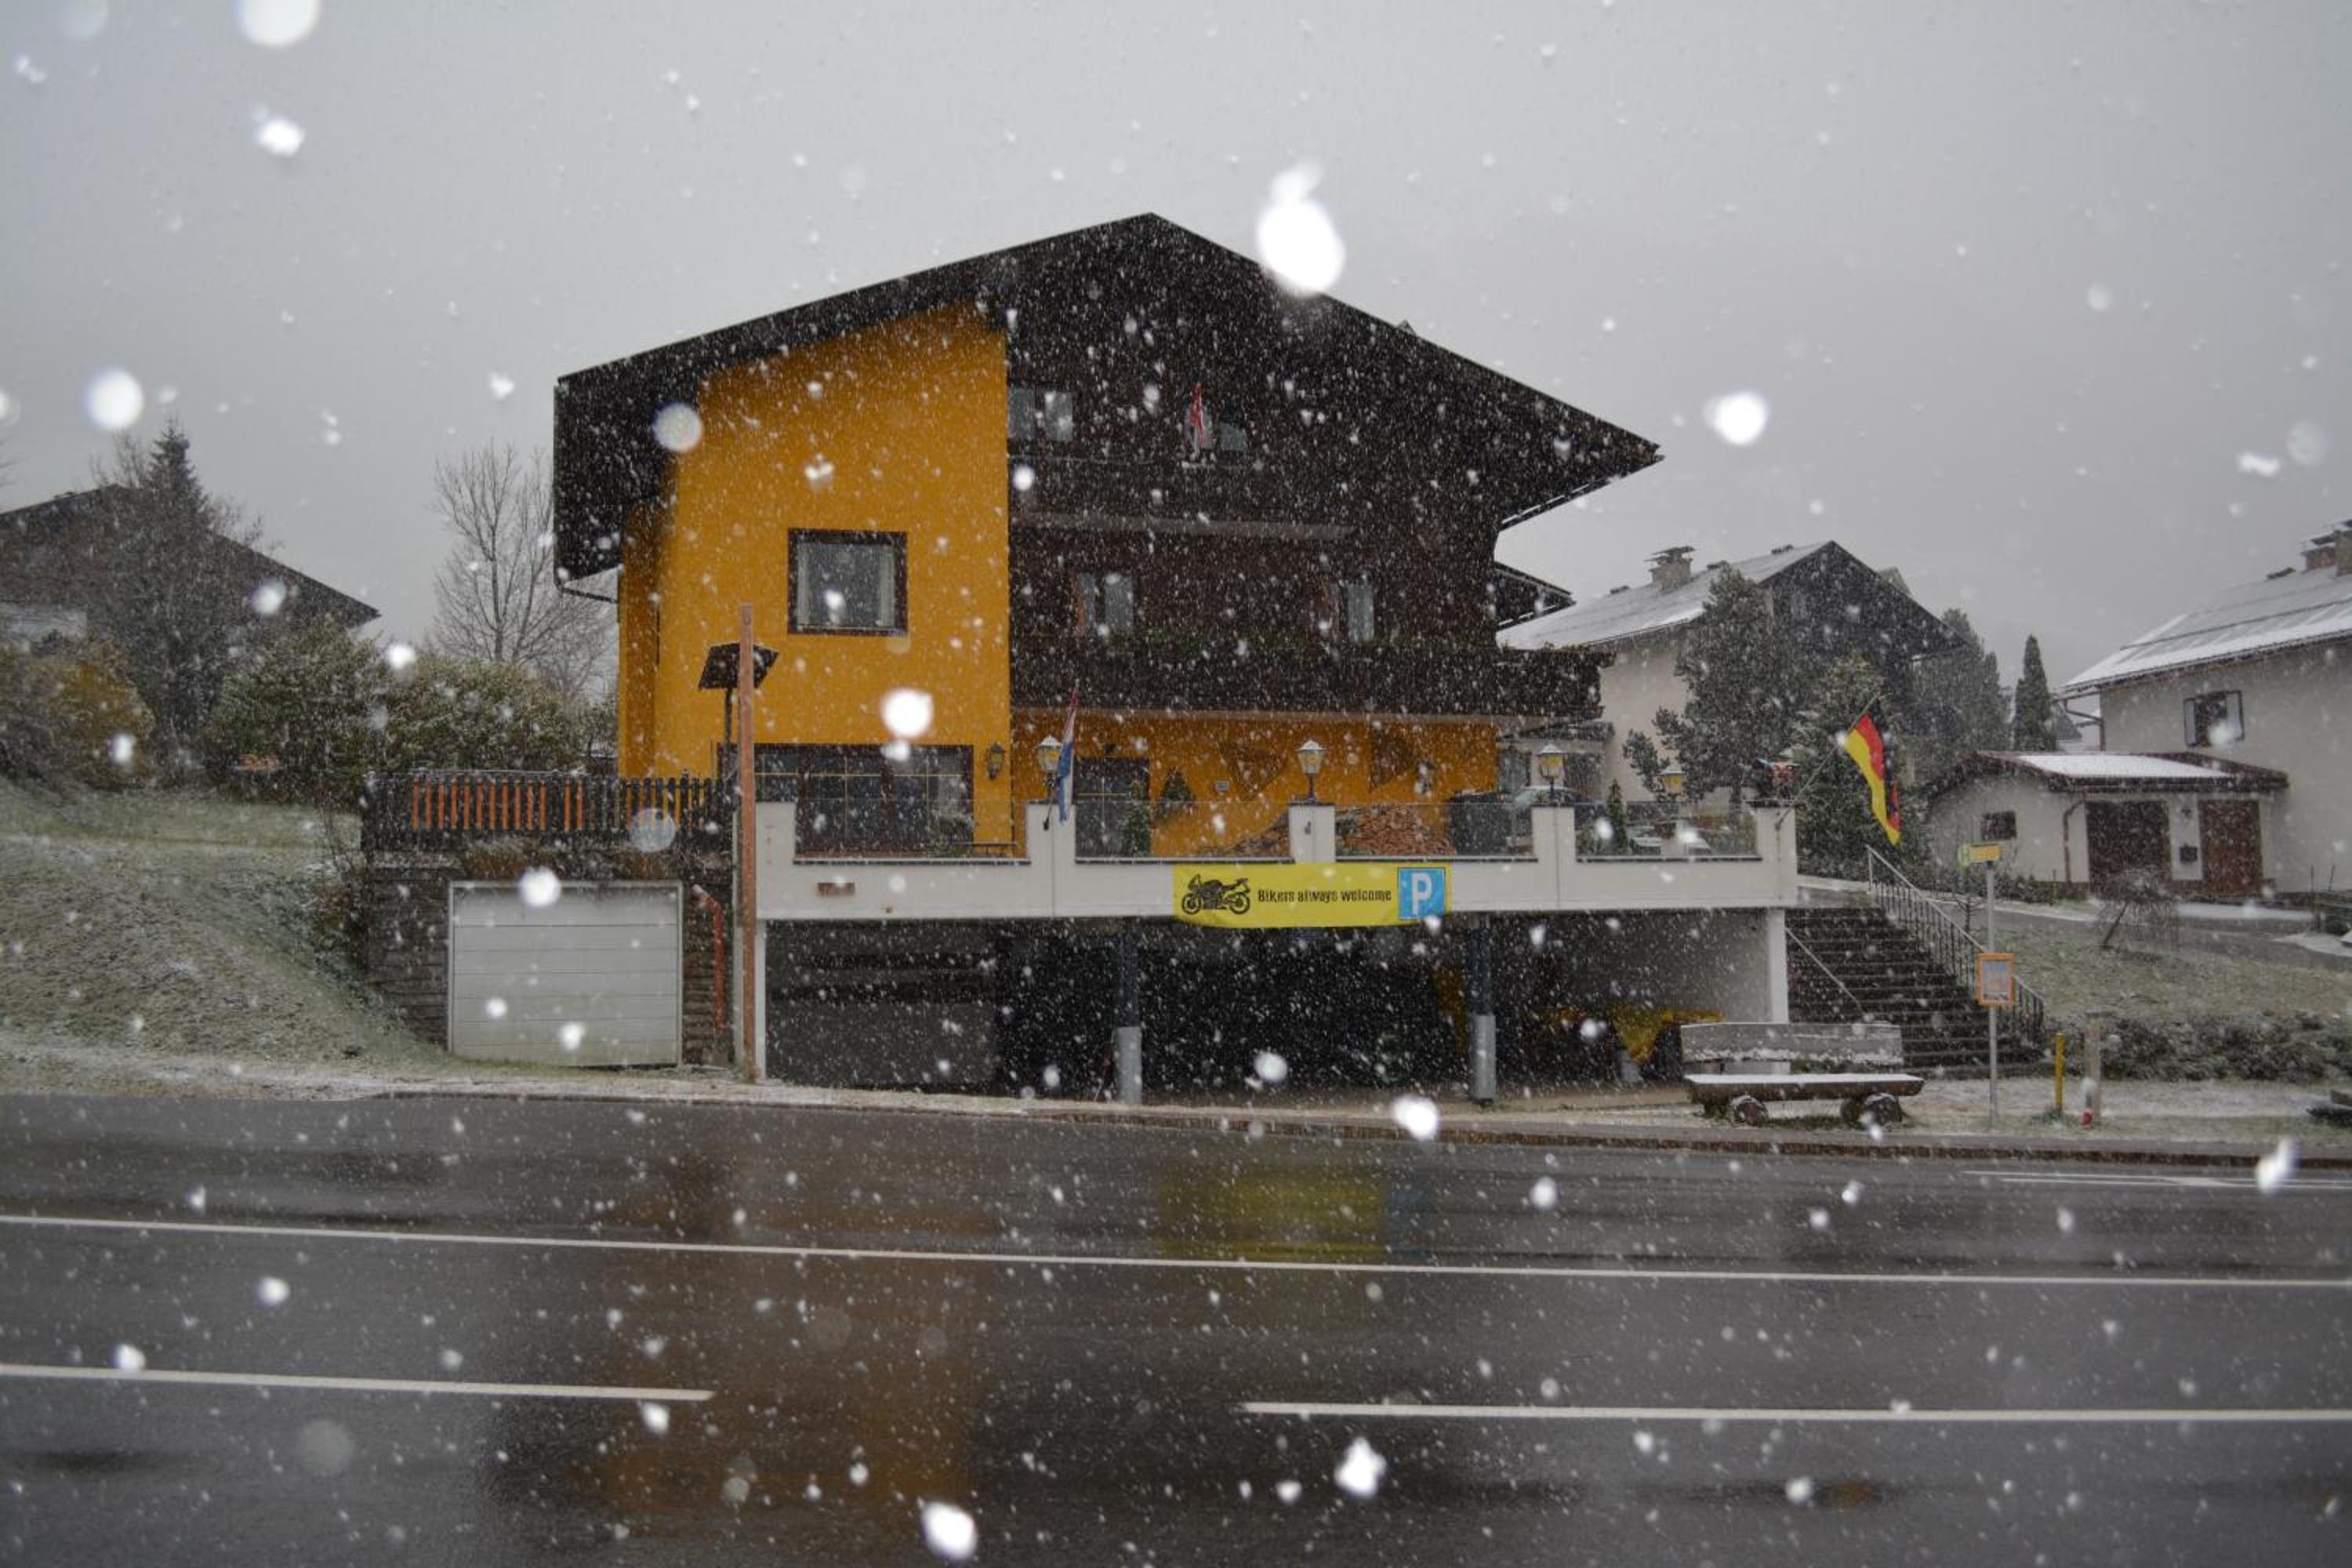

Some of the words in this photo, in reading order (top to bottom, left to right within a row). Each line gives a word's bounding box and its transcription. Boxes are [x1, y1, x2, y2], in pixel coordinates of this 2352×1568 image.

[1258, 890, 1294, 902] Bikers
[1298, 890, 1338, 903] always
[1341, 888, 1392, 902] welcome
[1412, 872, 1432, 916] P
